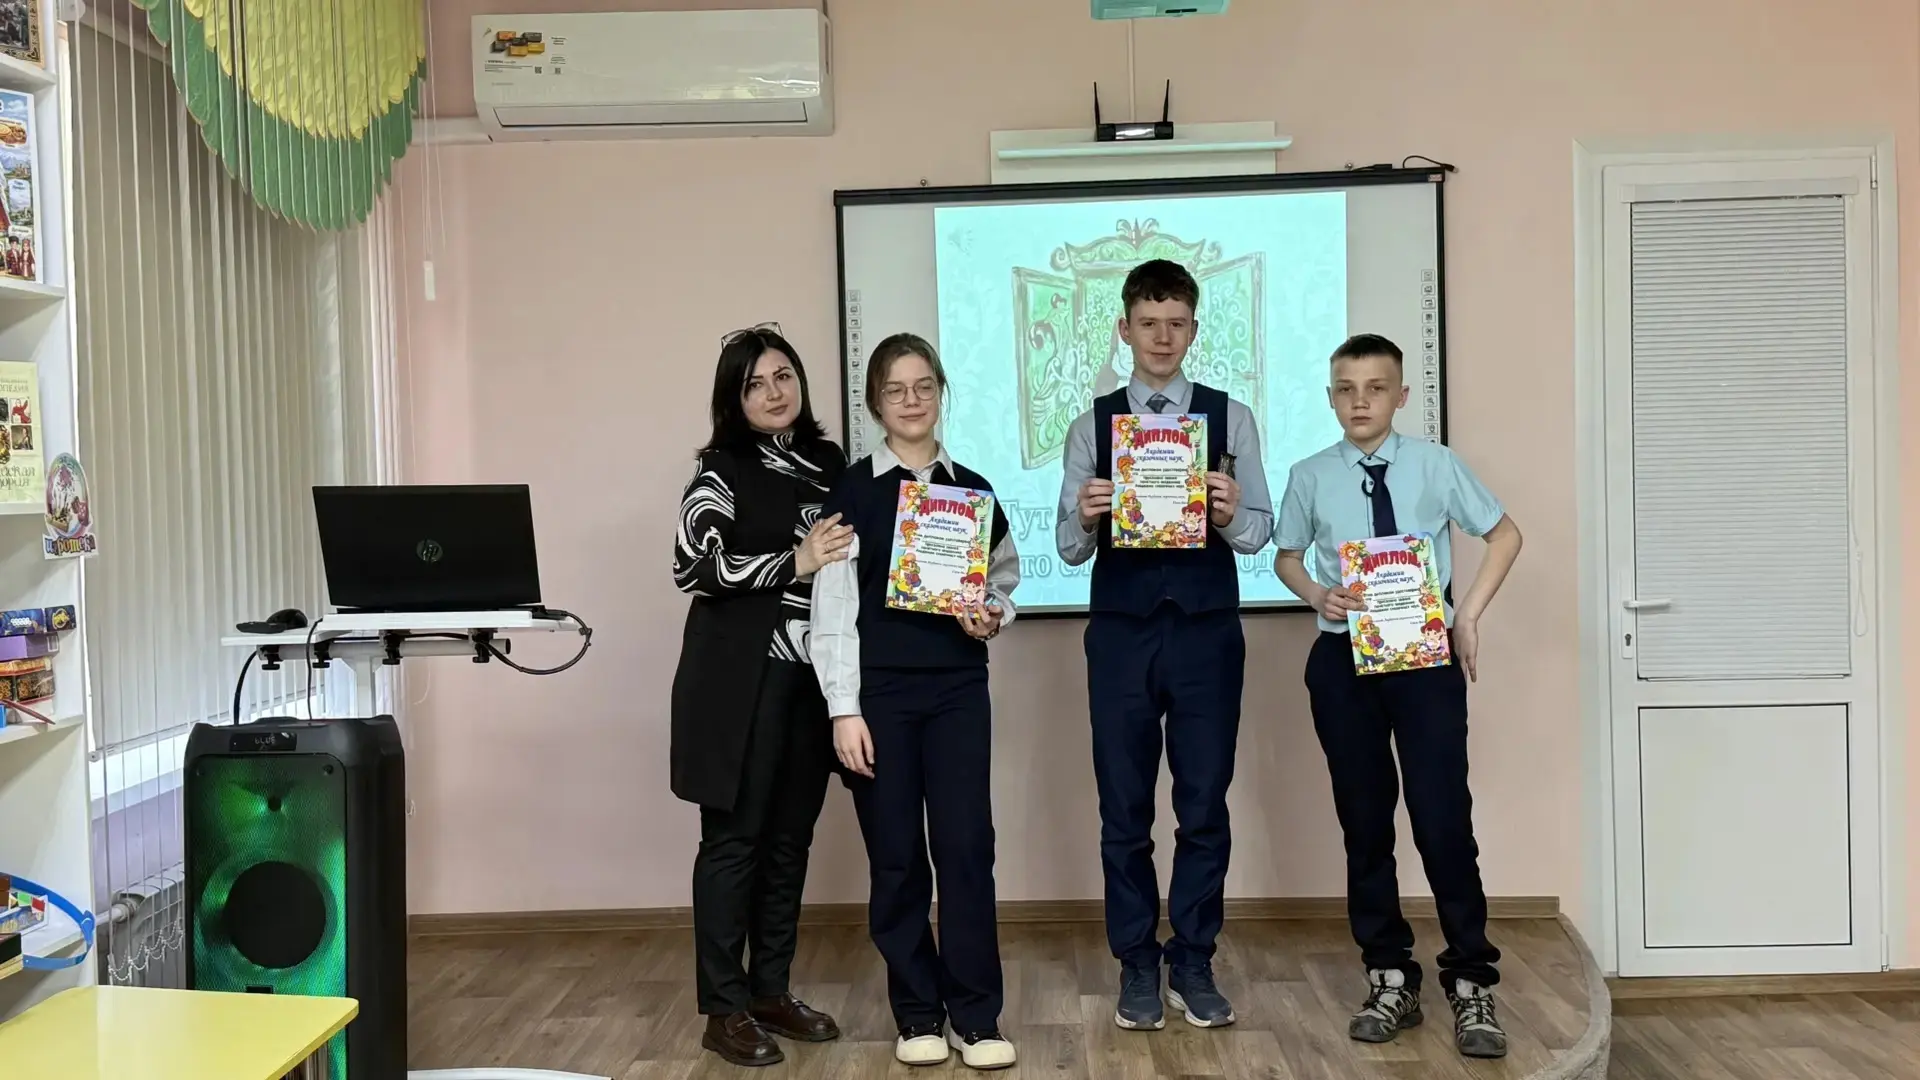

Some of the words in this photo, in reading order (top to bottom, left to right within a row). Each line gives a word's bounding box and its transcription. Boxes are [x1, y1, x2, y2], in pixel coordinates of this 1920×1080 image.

[1133, 428, 1192, 450] ДИПЛОМ
[919, 498, 977, 522] ДИПЛОМ
[1000, 499, 1052, 540] Тут
[1362, 550, 1421, 576] ДИПЛОМ
